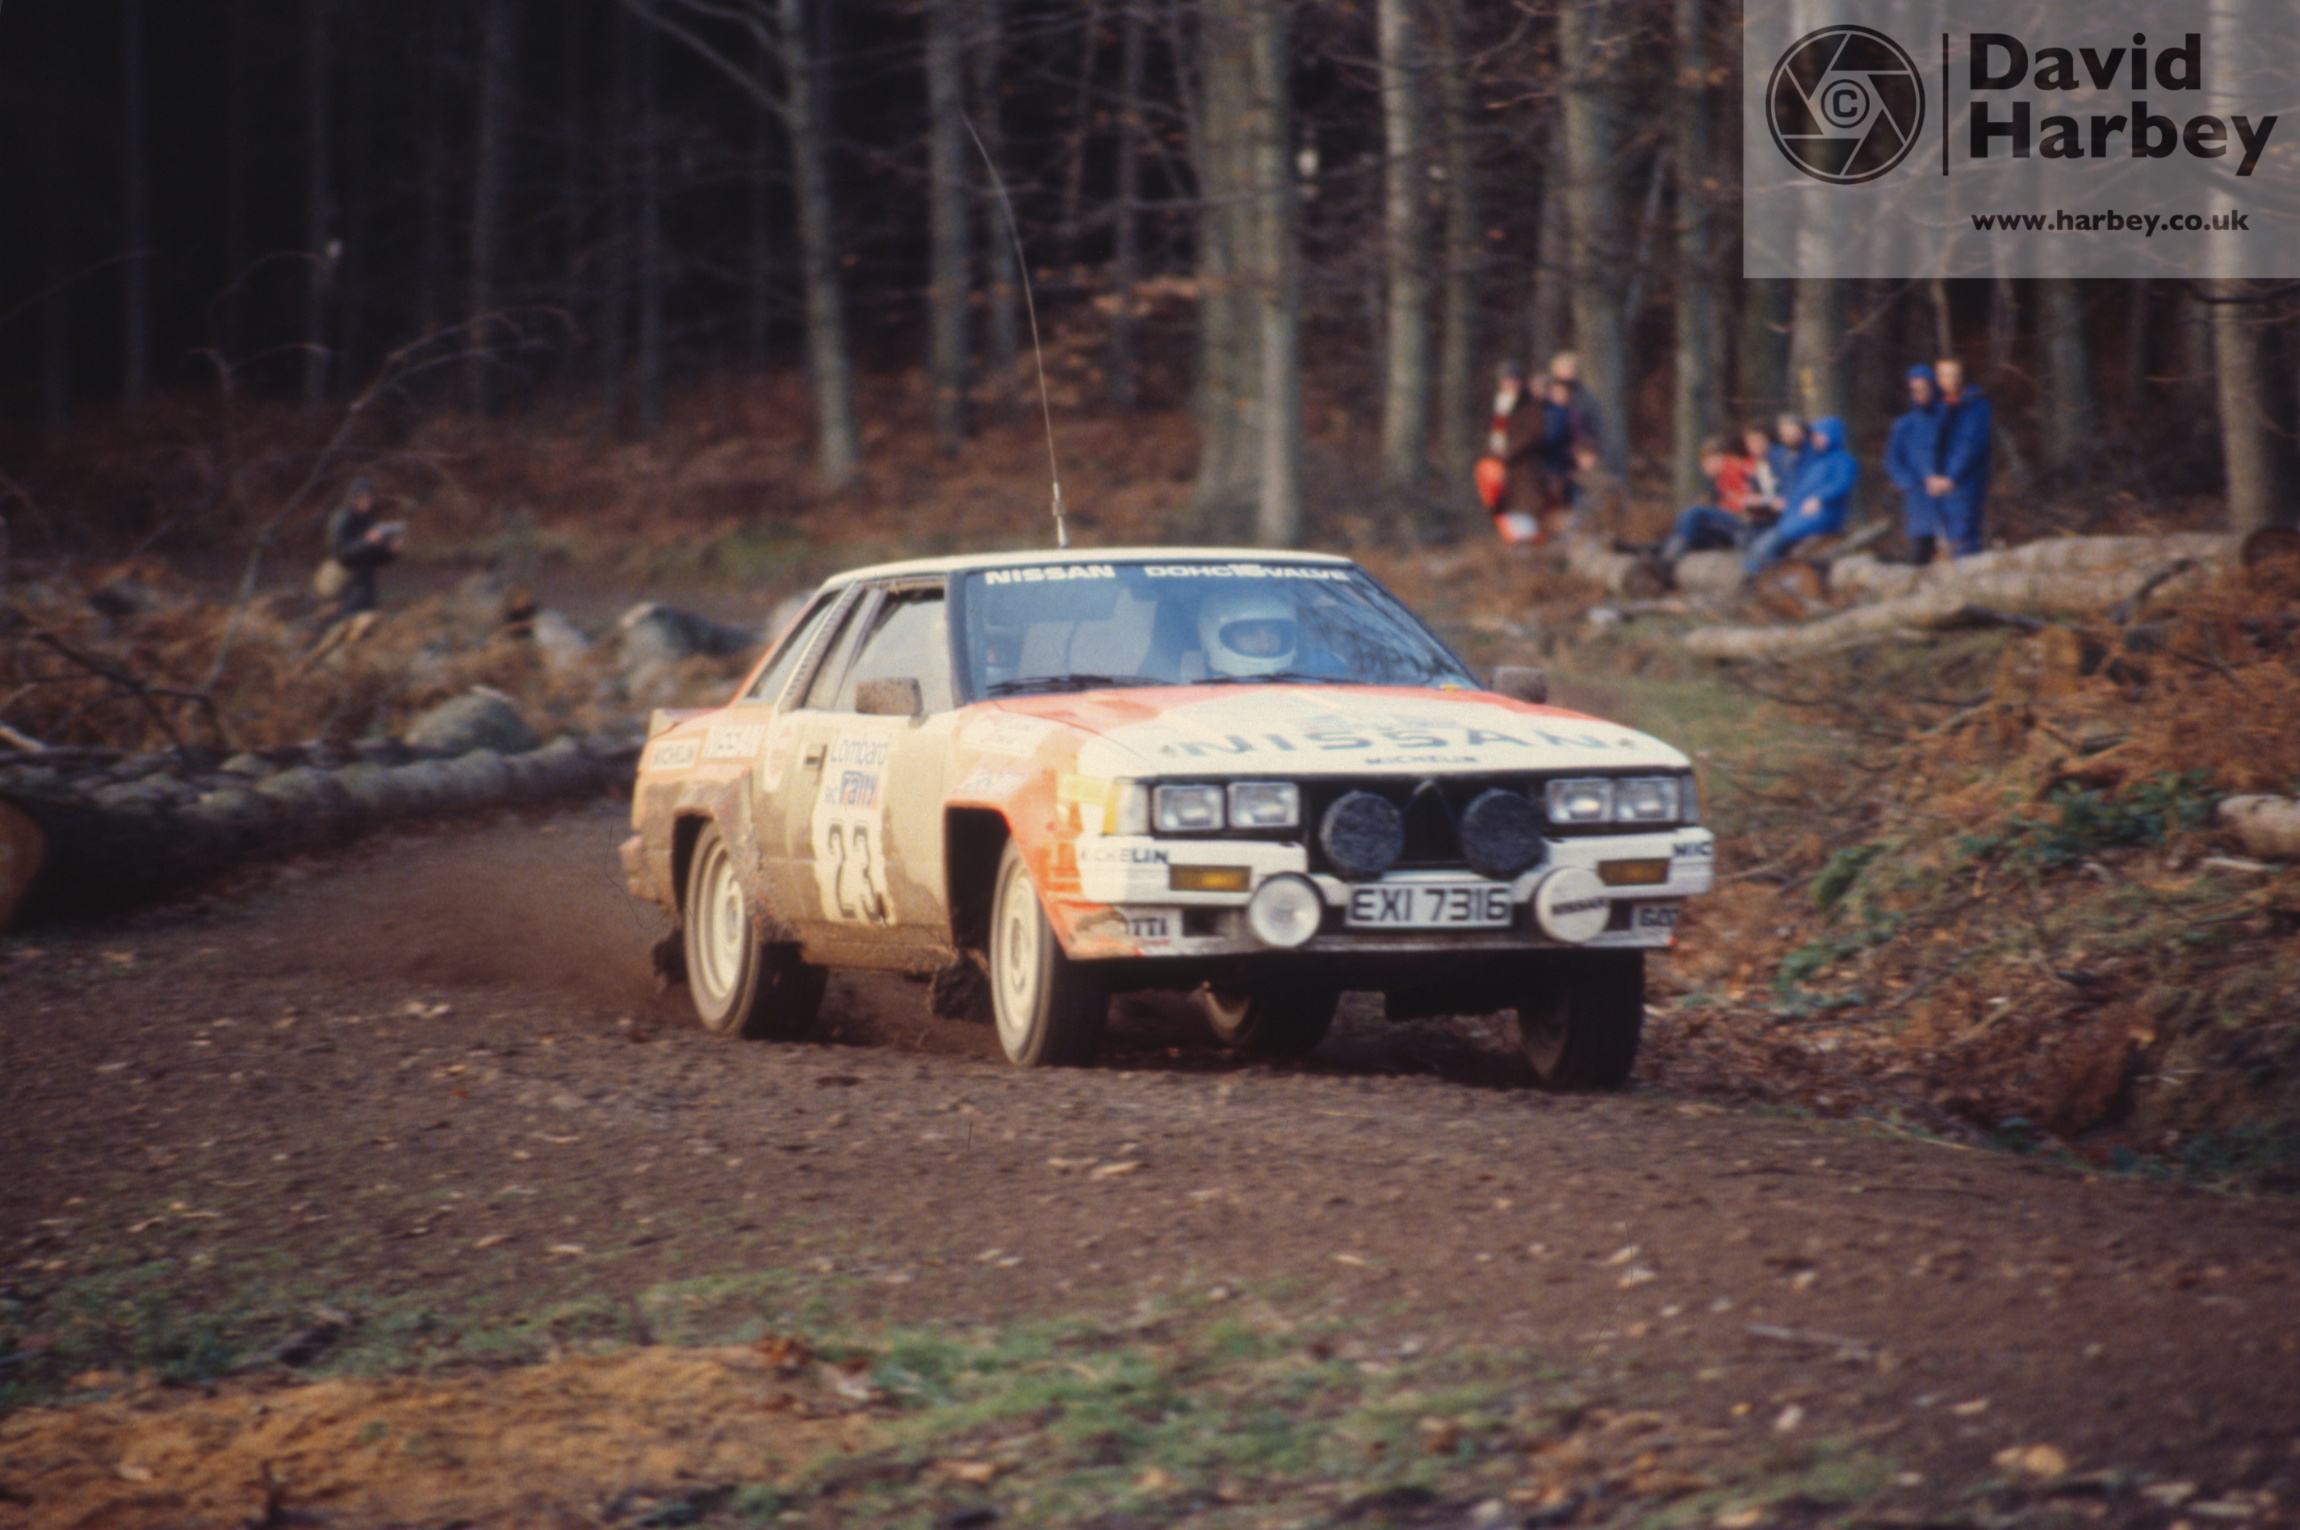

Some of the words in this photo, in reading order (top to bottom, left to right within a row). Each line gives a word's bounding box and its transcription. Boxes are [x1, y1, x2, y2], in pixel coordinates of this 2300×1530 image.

[984, 564, 1116, 586] NISSAN
[1177, 728, 1614, 757] NISSAN
[1352, 888, 1413, 921] EXI
[1424, 888, 1511, 921] 7316
